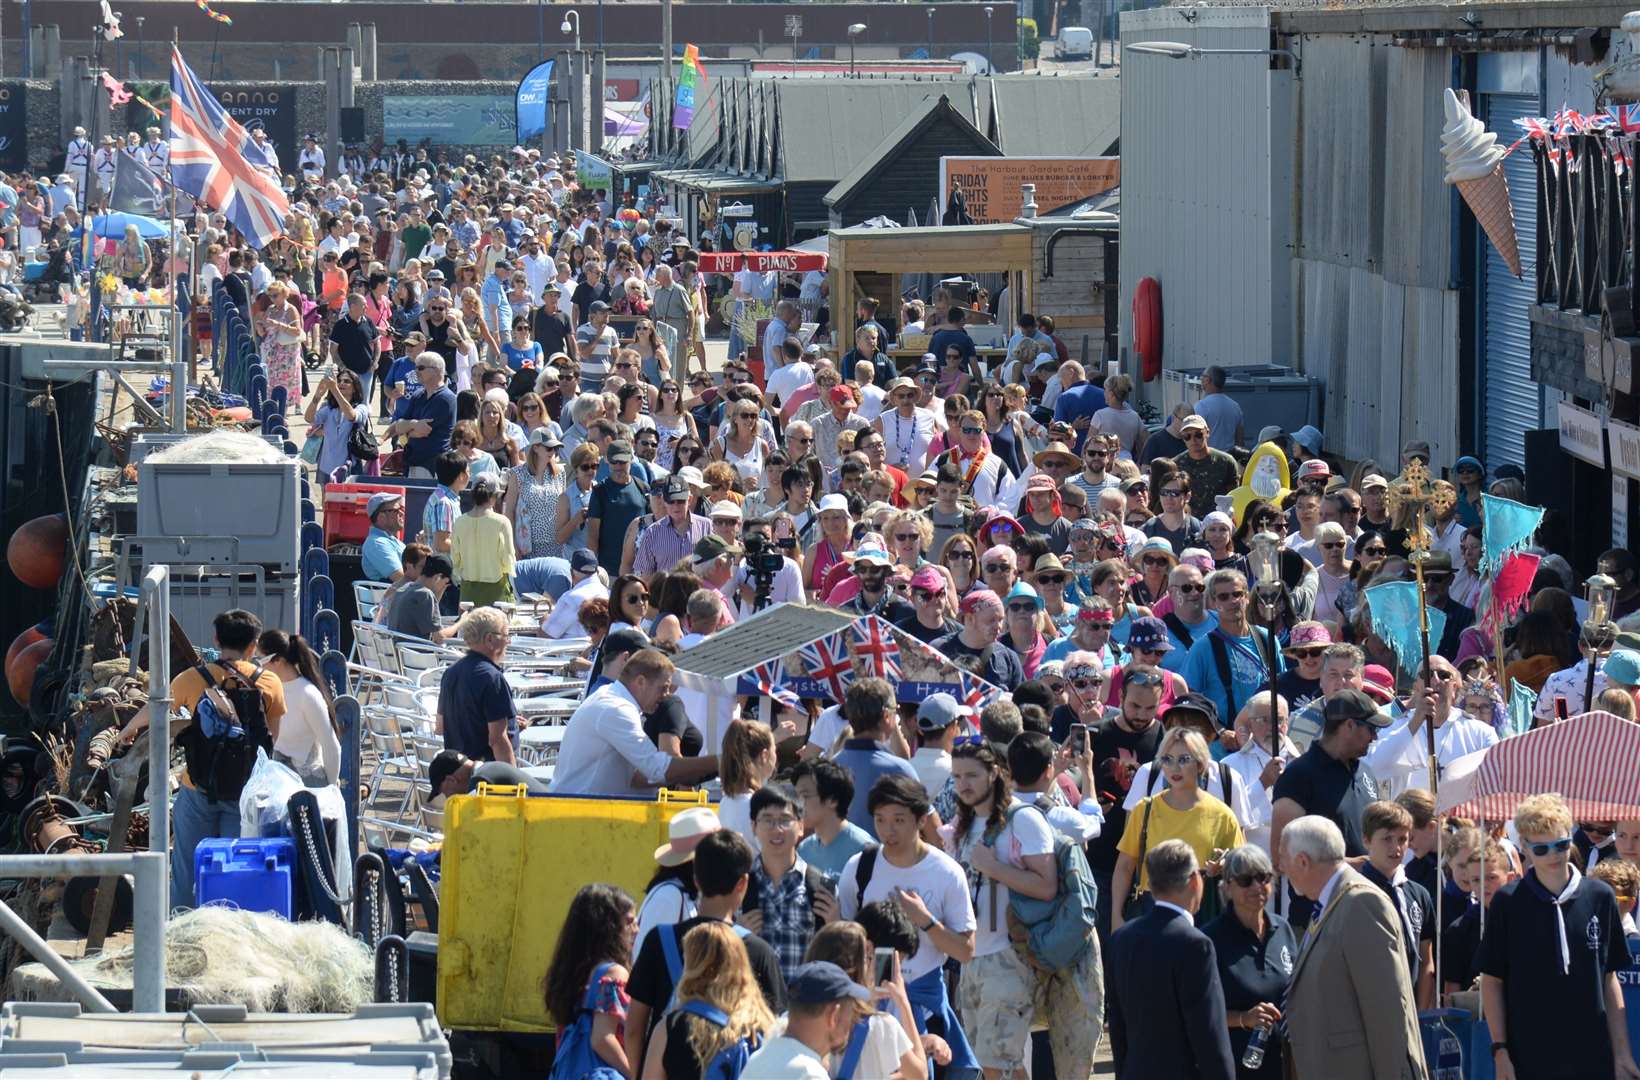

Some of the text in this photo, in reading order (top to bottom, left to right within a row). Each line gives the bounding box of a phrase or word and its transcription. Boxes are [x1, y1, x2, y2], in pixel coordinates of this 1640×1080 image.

[255, 107, 277, 116] DRY
[971, 165, 986, 173] The
[990, 165, 1026, 173] Harbour
[1029, 164, 1064, 173] Garden
[950, 173, 988, 187] FRIDAY
[967, 204, 988, 217] THE
[758, 255, 798, 271] PIMM'S
[916, 683, 958, 696] Here
